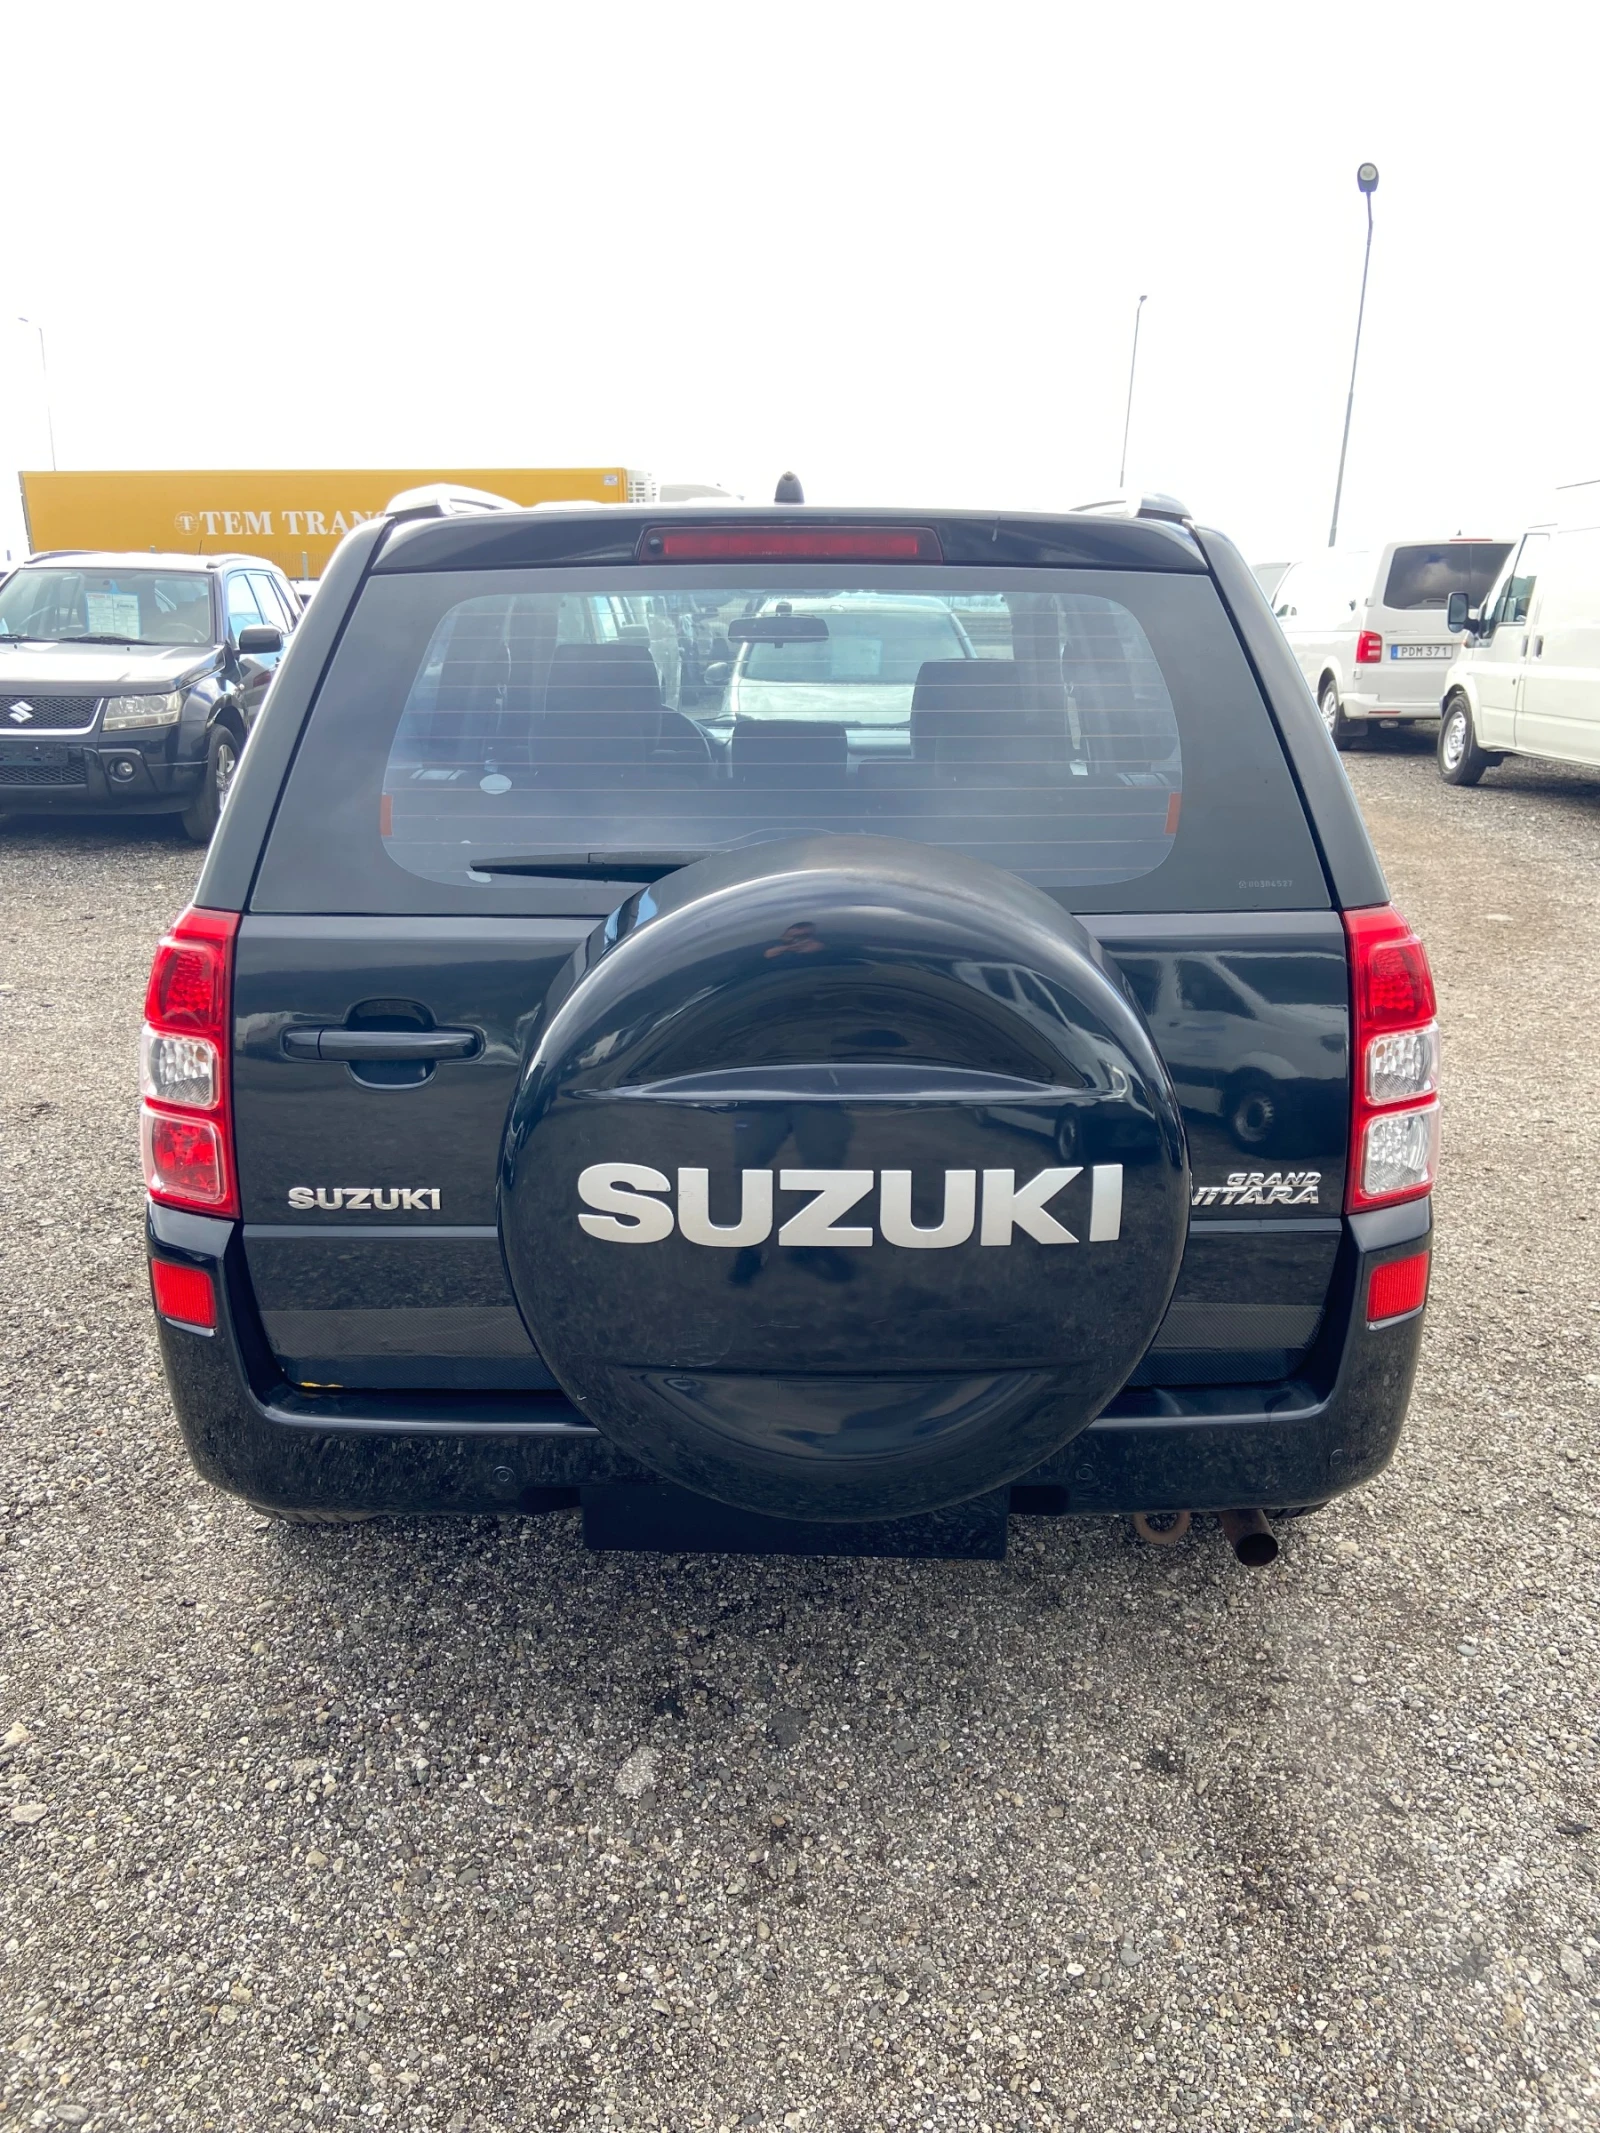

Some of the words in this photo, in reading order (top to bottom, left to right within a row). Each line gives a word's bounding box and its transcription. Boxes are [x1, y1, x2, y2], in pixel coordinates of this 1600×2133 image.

[199, 510, 275, 535] TEM
[1401, 646, 1423, 657] PDM
[1426, 646, 1447, 657] 371
[1226, 1171, 1322, 1187] GRAND
[288, 1186, 441, 1210] SUZUKI
[577, 1162, 1123, 1249] SUZUKI
